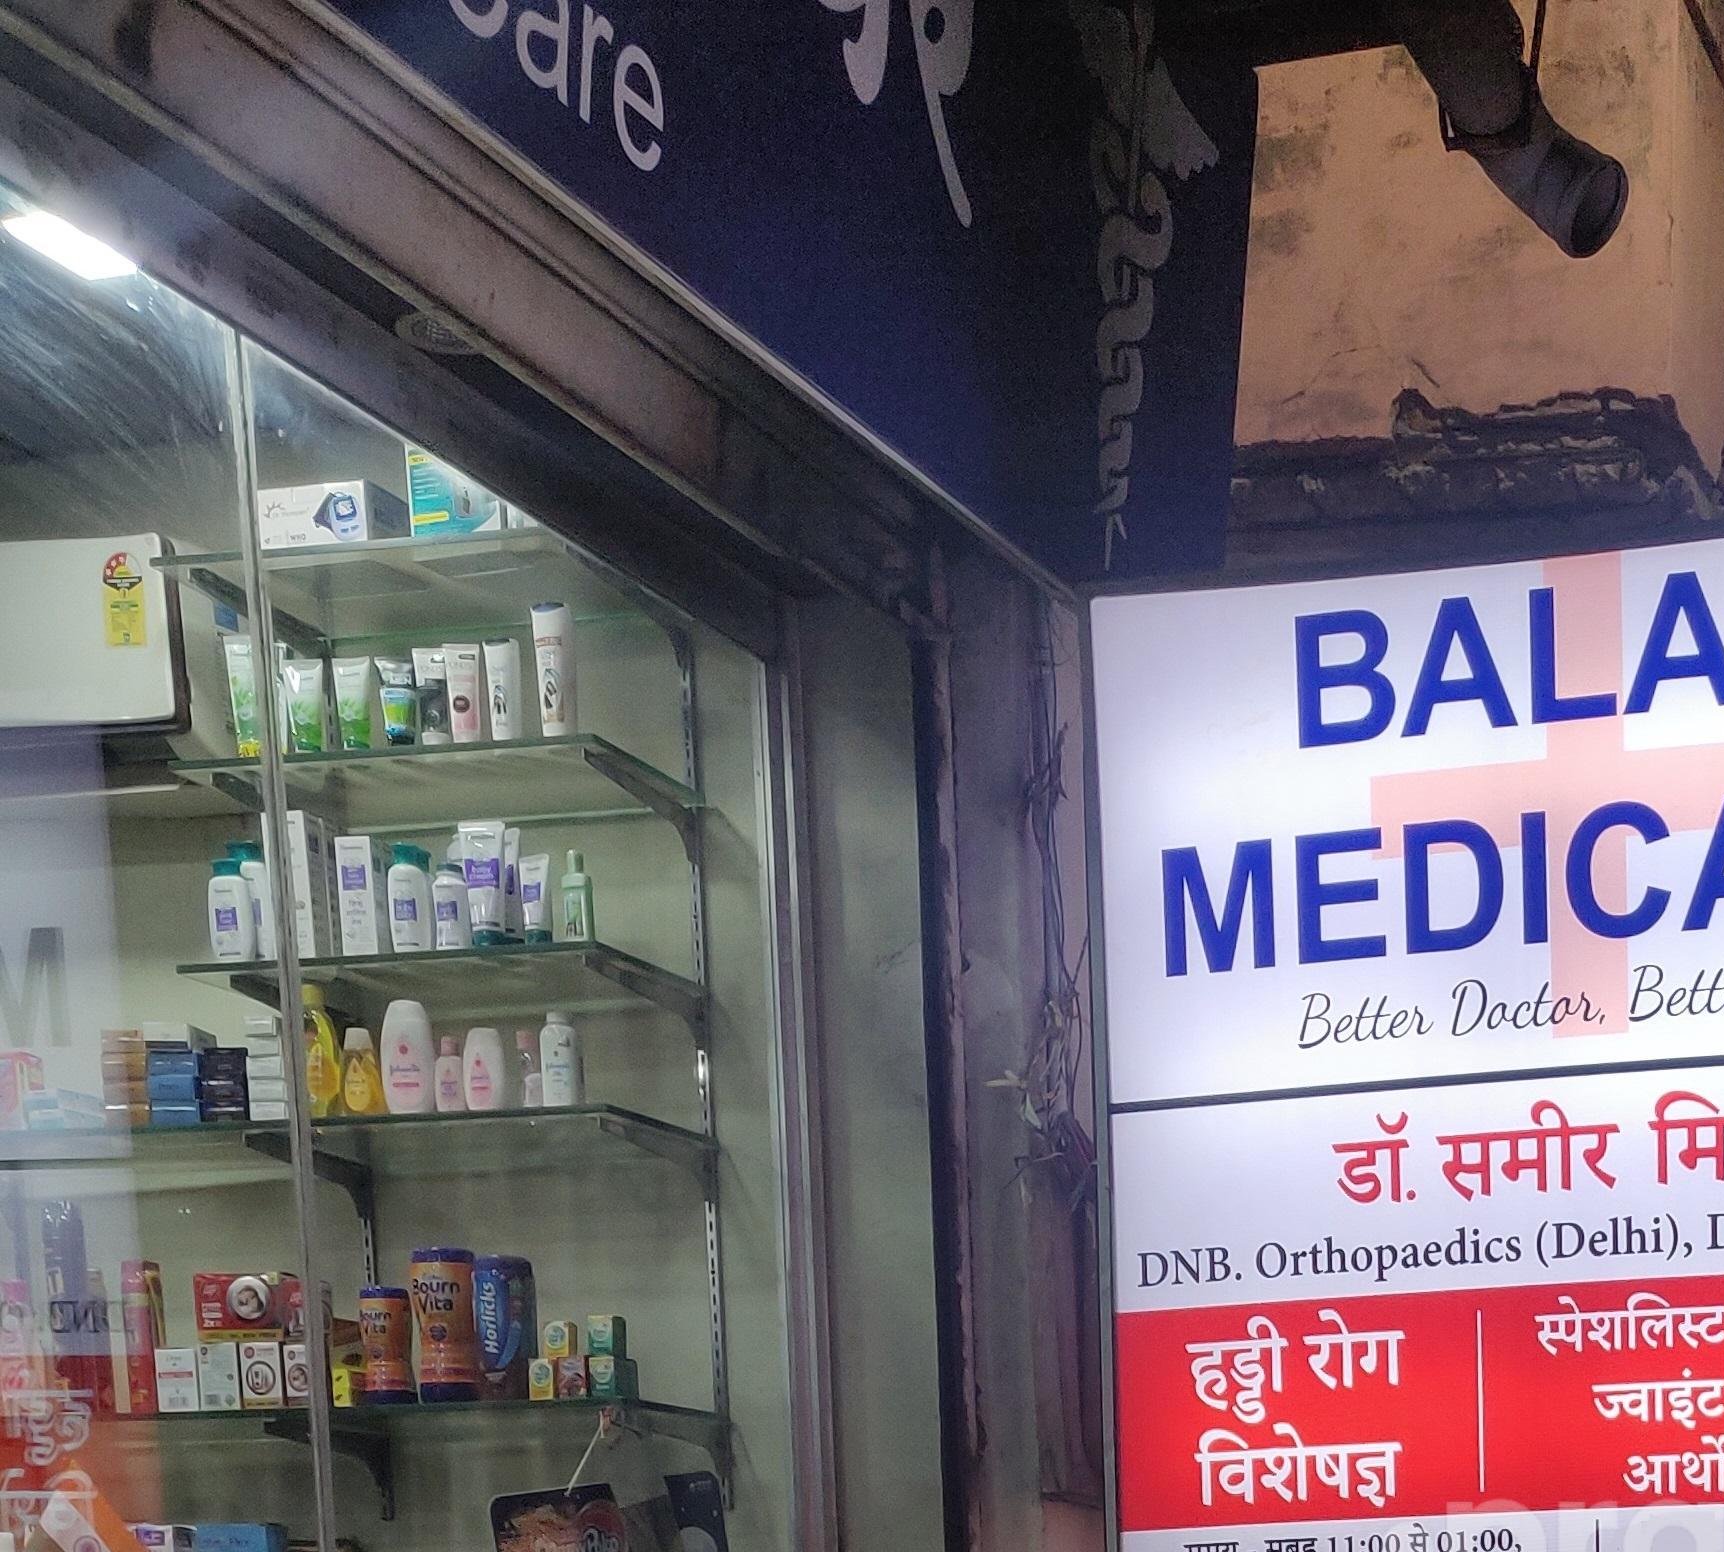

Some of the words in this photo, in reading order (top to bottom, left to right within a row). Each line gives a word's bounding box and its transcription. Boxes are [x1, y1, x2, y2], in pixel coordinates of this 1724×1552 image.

[1297, 992, 1434, 1050] Better
[1451, 979, 1606, 1037] Doctor,
[1331, 1111, 1417, 1204] डॉ.
[1435, 1099, 1621, 1202] समीर
[1137, 1246, 1242, 1288] DNB.
[1255, 1226, 1522, 1283] Orthopaedics
[1536, 1213, 1693, 1268] (Delhi),
[480, 1281, 498, 1355] Horlicks
[1185, 1315, 1289, 1424] हड्डी
[1302, 1308, 1406, 1390] रोग
[1193, 1421, 1403, 1508] विशेषज्ञ
